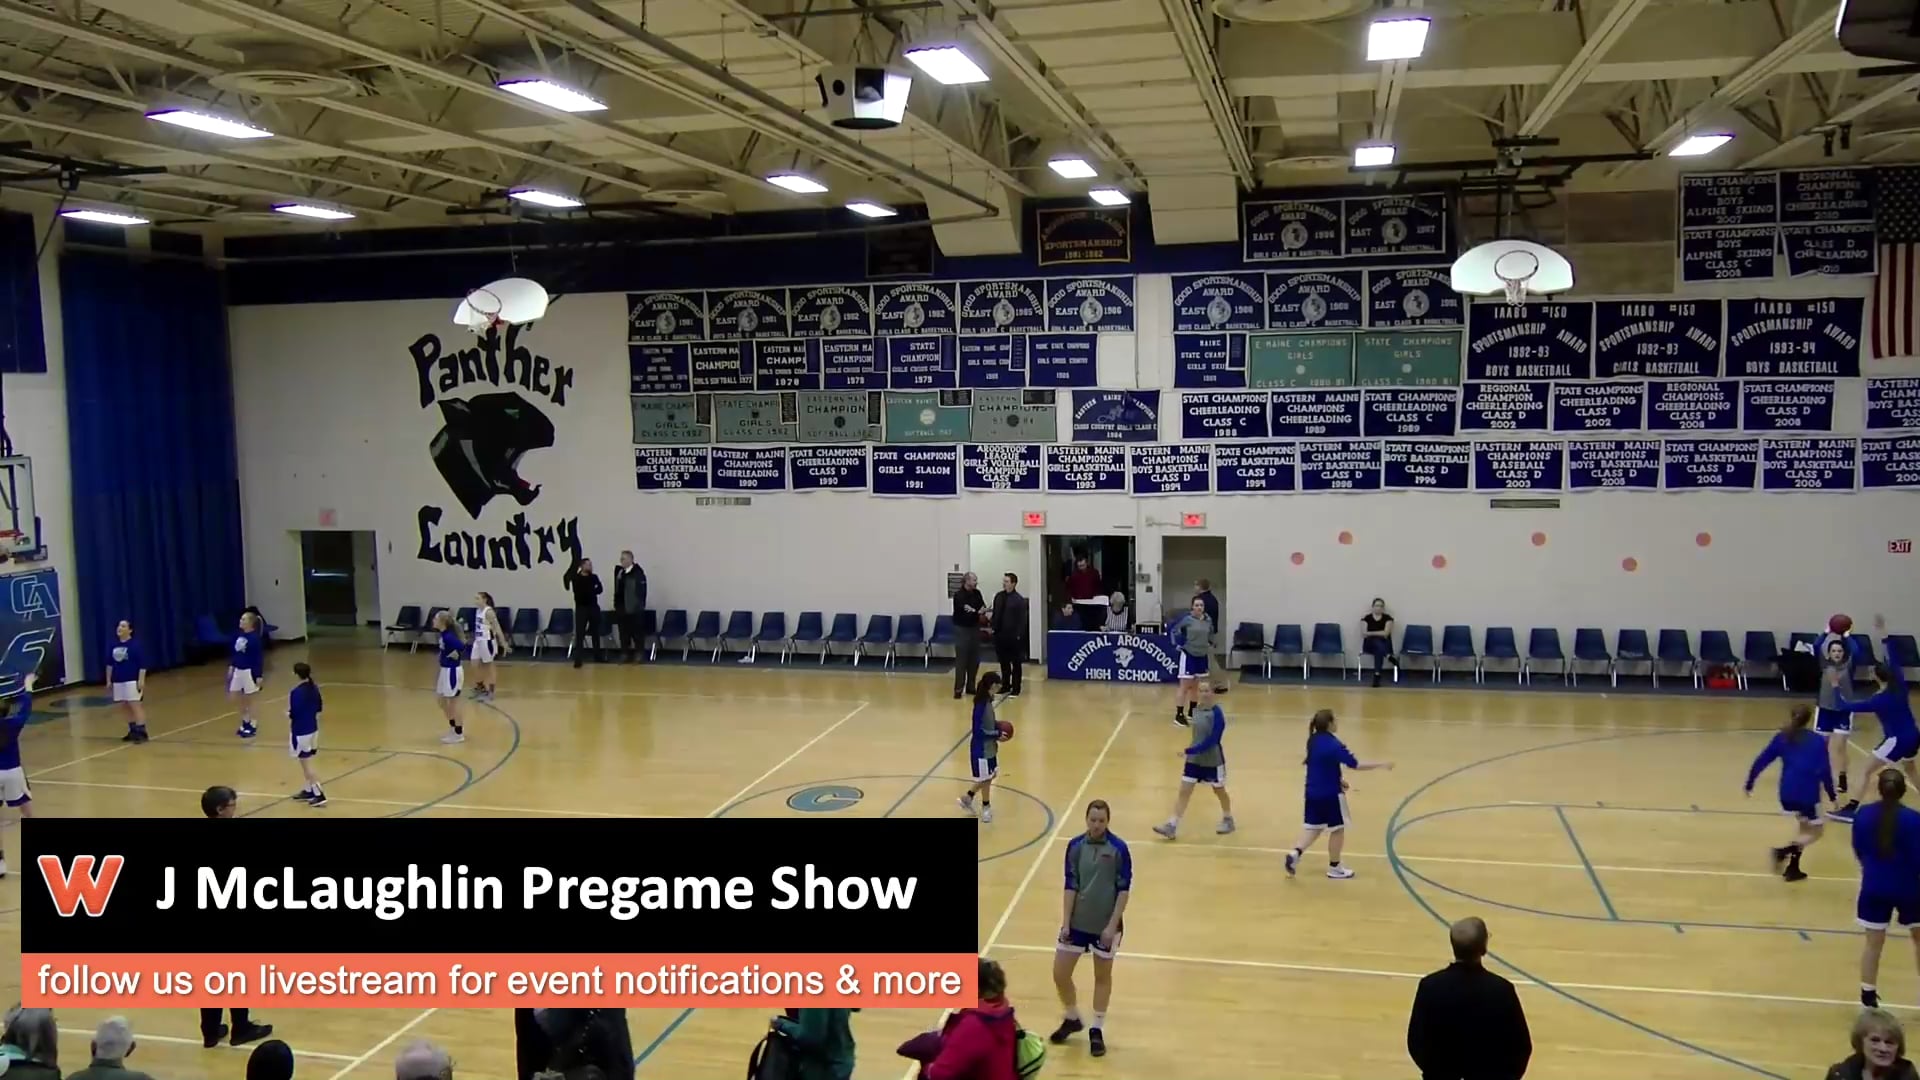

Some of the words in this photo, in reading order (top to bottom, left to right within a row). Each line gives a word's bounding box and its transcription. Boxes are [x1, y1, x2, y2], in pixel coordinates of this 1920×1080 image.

[1685, 231, 1712, 240] STATE
[1716, 240, 1742, 249] BOYS
[1685, 251, 1723, 261] ALPINE
[1736, 248, 1772, 258] SKIING
[1705, 261, 1739, 269] CLASS
[1075, 288, 1106, 297] AWARD
[1202, 288, 1234, 296] AWARD
[1055, 307, 1079, 316] EAST
[1181, 307, 1207, 316] EAST
[1494, 306, 1528, 319] IAABO
[1621, 304, 1655, 317] IAABO
[1754, 302, 1792, 315] IAABO
[1472, 322, 1547, 353] SPORTSMANSHIP
[1555, 328, 1588, 354] AWARD
[1599, 320, 1675, 352] SPORTSMANSHIP
[1685, 326, 1718, 351] AWARD
[1731, 318, 1813, 347] SPORTSMANSHIP
[1823, 322, 1857, 350] AWARD
[910, 342, 935, 350] STATE
[1637, 343, 1679, 356] 1992-93
[1769, 341, 1816, 354] 1993-94
[1508, 345, 1550, 358] 1992-93
[408, 321, 573, 409] Panther
[1612, 361, 1639, 373] GIRLS
[1645, 361, 1700, 374] BASKETBALL
[1745, 361, 1771, 373] BOYS
[1779, 361, 1839, 374] BASKETBALL
[1485, 364, 1510, 377] BOYS
[1515, 364, 1572, 377] BASKETBALL
[1480, 384, 1531, 393] REGIONAL
[1666, 383, 1720, 392] REGIONAL
[1744, 384, 1772, 393] STATE
[1774, 384, 1834, 393] CHAMPIONS
[1868, 380, 1919, 388] EASTERN
[1554, 386, 1581, 395] STATE
[1584, 385, 1643, 395] CHAMPIONS
[1183, 394, 1209, 403] STATE
[1212, 394, 1268, 403] CHAMPIONS
[1273, 394, 1315, 403] EASTERN
[1325, 394, 1359, 403] MAINE
[1365, 392, 1392, 401] STATE
[1398, 392, 1457, 402] CHAMPIONS
[1477, 393, 1533, 401] CHAMPION
[1662, 392, 1725, 401] CHAMPIONS
[1751, 396, 1826, 405] CHEERLEADING
[1465, 402, 1544, 410] CHEERLEADING
[1560, 397, 1636, 407] CHEERLEADING
[1655, 402, 1731, 411] CHEERLEADING
[1870, 401, 1893, 409] BOYS
[1189, 406, 1261, 415] CHEERLEADING
[1287, 404, 1345, 413] CHAMPIONS
[1372, 402, 1448, 412] CHEERLEADING
[1575, 407, 1607, 416] CLASS
[1613, 406, 1621, 416] D
[1765, 407, 1798, 416] CLASS
[1803, 406, 1811, 415] D
[1279, 415, 1352, 424] CHEERLEADING
[1385, 413, 1418, 422] CLASS
[1425, 413, 1433, 422] C
[1481, 411, 1513, 420] CLASS
[1519, 411, 1526, 419] D
[1670, 412, 1702, 420] CLASS
[1707, 412, 1716, 420] D
[1203, 418, 1232, 427] CLASS
[1239, 417, 1247, 426] C
[1490, 420, 1517, 429] 2002
[1585, 418, 1612, 428] 2002
[1398, 424, 1420, 433] 1989
[976, 445, 1027, 453] AROOSTOOK
[1386, 444, 1412, 452] STATE
[1415, 444, 1469, 453] CHAMPIONS
[1476, 443, 1521, 451] EASTERN
[1530, 442, 1561, 451] MAINE
[1763, 440, 1810, 449] EASTERN
[1819, 440, 1856, 449] MAINE
[713, 450, 748, 459] EASTERN
[756, 450, 784, 459] MAINE
[1048, 446, 1088, 455] EASTERN
[1094, 446, 1125, 454] MAINE
[1776, 450, 1843, 459] CHAMPIONS
[873, 452, 898, 460] STATE
[904, 451, 957, 460] CHAMPIONS
[1058, 455, 1113, 463] CHAMPIONS
[1386, 454, 1408, 462] BOYS
[1411, 454, 1468, 463] BASKETBALL
[1487, 452, 1551, 460] CHAMPIONS
[724, 460, 773, 468] CHAMPIONS
[964, 459, 988, 467] GIRLS
[990, 459, 1040, 467] VOLLEYBALL
[1492, 461, 1545, 469] BASEBALL
[1764, 461, 1787, 469] BOYS
[1793, 460, 1853, 469] BASKETBALL
[717, 469, 779, 478] CHEERLEADING
[879, 466, 904, 474] GIRLS
[915, 466, 950, 474] SLALOM
[976, 467, 1027, 475] CHAMPIONS
[1405, 465, 1434, 474] CLASS
[1441, 466, 1448, 474] D
[1065, 473, 1093, 481] CLASS
[1415, 475, 1436, 484] 1996
[739, 480, 758, 488] 1990
[905, 480, 923, 488] 1991
[1506, 480, 1531, 488] 2003
[1794, 479, 1822, 488] 2006
[417, 505, 583, 591] Country
[1890, 540, 1909, 552] EXIT
[1067, 635, 1112, 672] CENTRAL
[1117, 635, 1178, 675] AROOSTOOK
[1085, 668, 1112, 680] HIGH
[1118, 668, 1161, 683] SCHOOL
